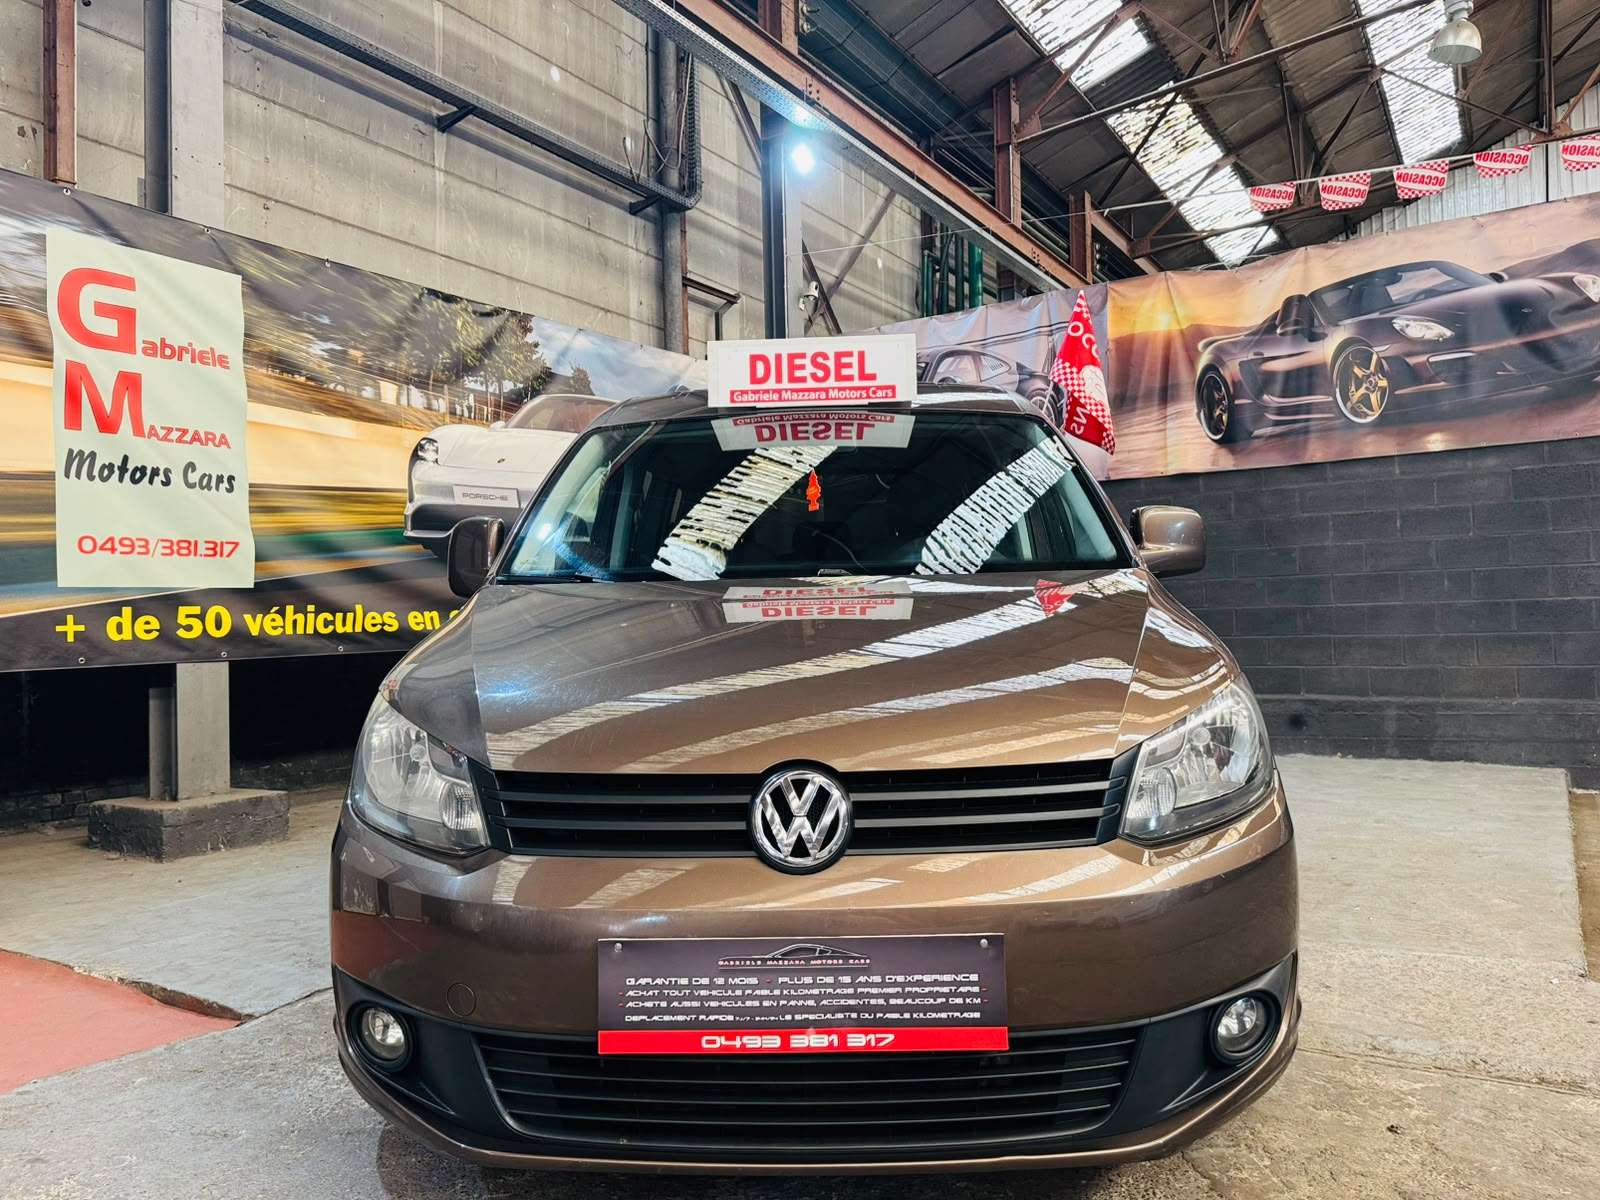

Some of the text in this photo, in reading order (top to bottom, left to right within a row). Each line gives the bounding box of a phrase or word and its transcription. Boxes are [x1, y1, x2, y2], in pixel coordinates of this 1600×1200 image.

[749, 350, 878, 385] DIESEL
[733, 387, 894, 403] Gabriele Mazzara Motors Cars
[63, 447, 236, 494] Motors Cars
[462, 492, 509, 502] PORSCHE
[77, 535, 240, 558] 0493/381.317
[106, 606, 161, 641] de
[175, 605, 232, 639] 50
[243, 603, 400, 637] véhicules
[407, 608, 440, 631] en
[626, 977, 690, 986] GARANTIE
[692, 977, 710, 985] DE
[713, 977, 725, 985] 12
[728, 977, 759, 985] MOIS
[778, 976, 813, 985] PLUS
[816, 975, 835, 984] DE
[855, 974, 882, 983] ANS
[885, 973, 979, 983] D'EXPERIENCE
[626, 989, 660, 997] ACHAT
[857, 986, 902, 995] PREMIER
[889, 997, 946, 1005] BEAUCOUP
[701, 1033, 896, 1048] 0493 381 317
